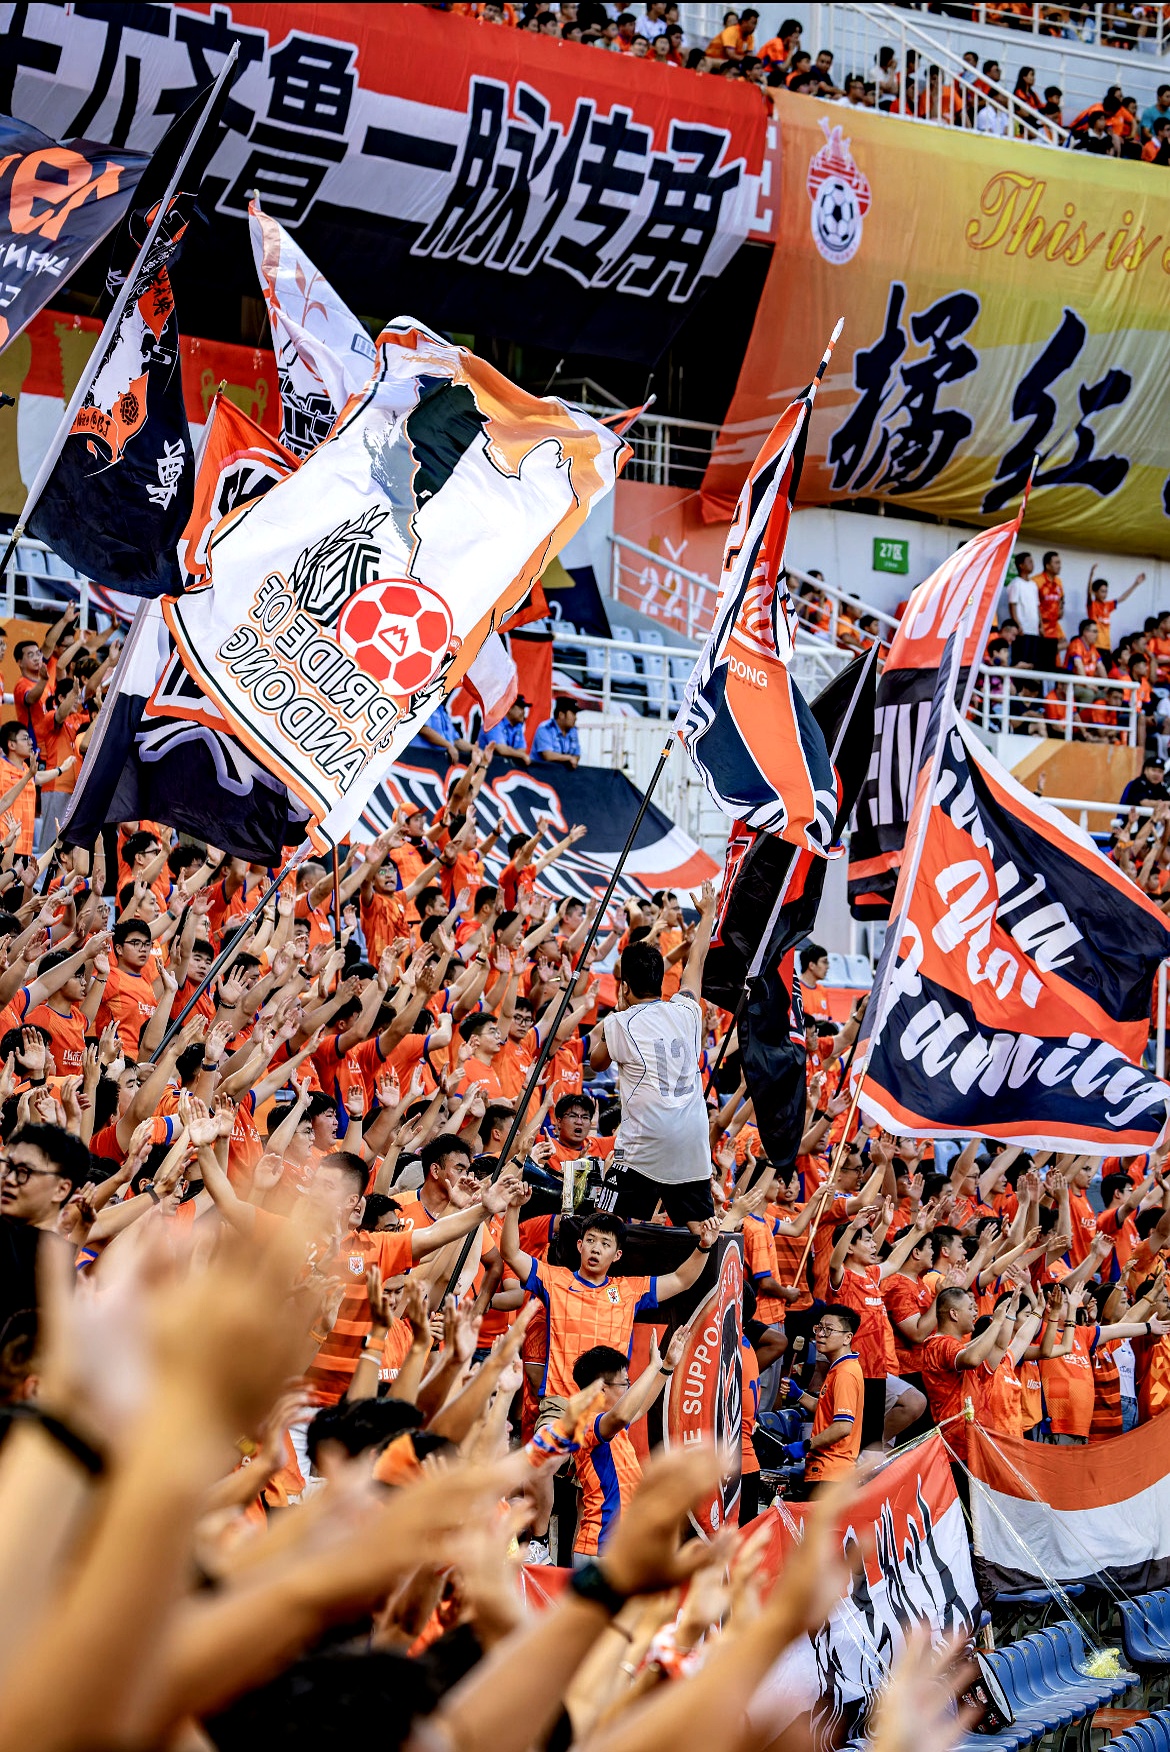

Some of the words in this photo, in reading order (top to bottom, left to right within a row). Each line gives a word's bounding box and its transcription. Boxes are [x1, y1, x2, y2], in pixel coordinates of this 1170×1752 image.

[965, 171, 1106, 266] This
[1105, 209, 1163, 272] is
[826, 280, 1170, 515] 橘红
[880, 543, 903, 561] 27区
[729, 655, 768, 687] DONG
[653, 1038, 695, 1098] 12
